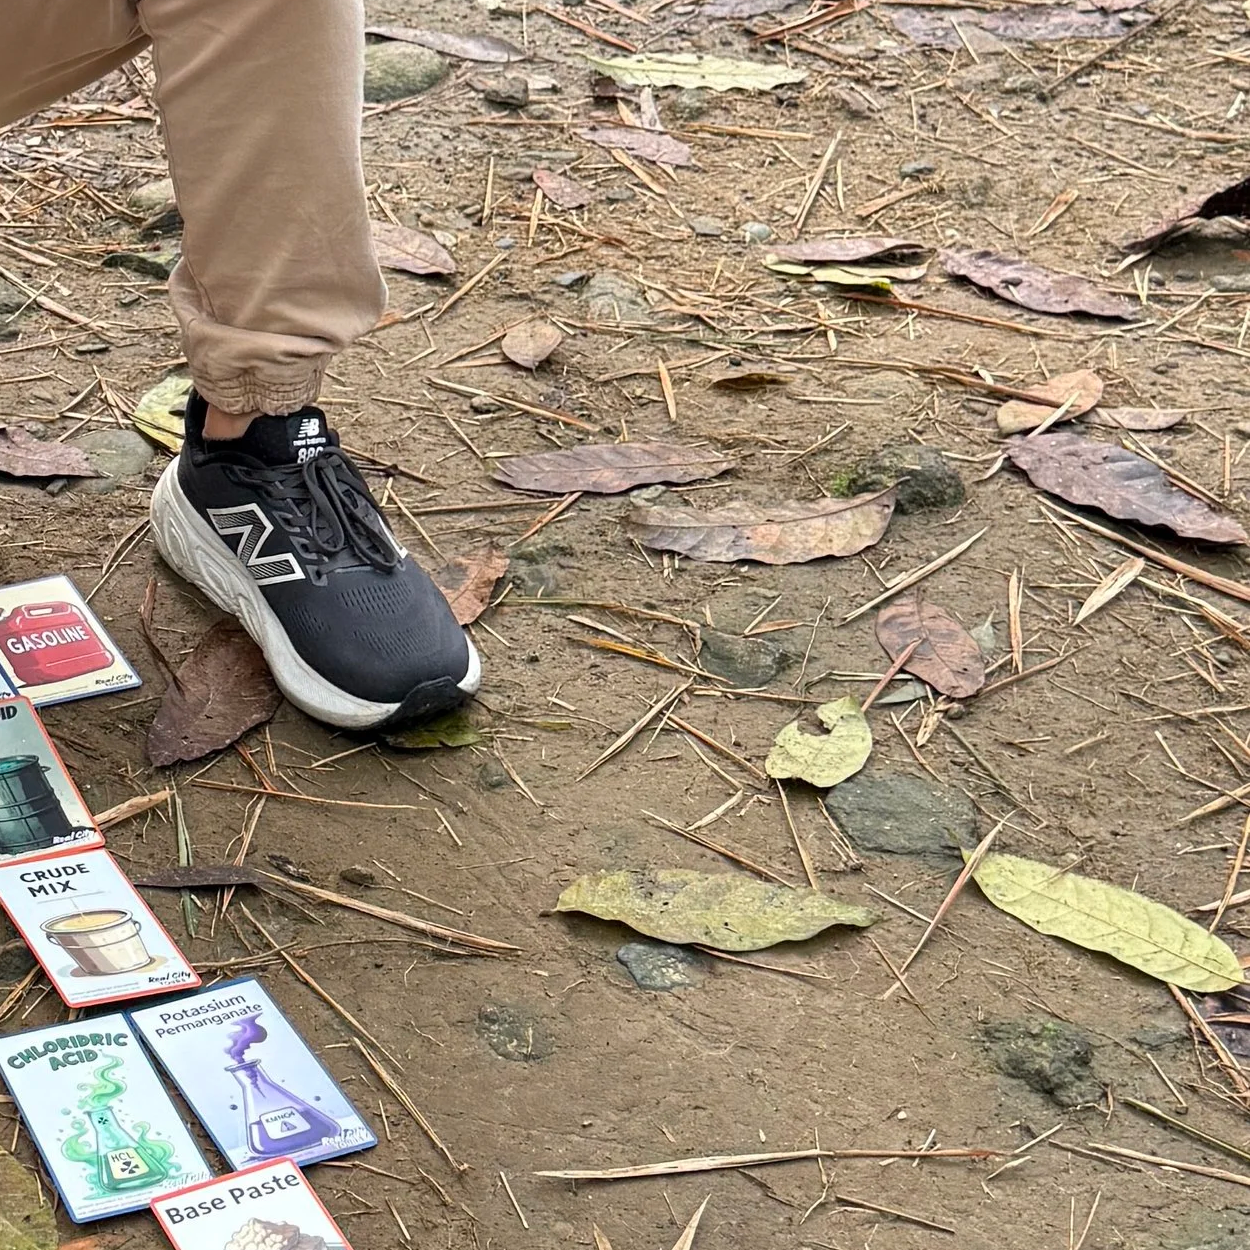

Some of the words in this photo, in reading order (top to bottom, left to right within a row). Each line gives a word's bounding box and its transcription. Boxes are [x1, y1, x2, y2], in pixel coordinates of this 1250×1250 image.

[7, 625, 89, 654] GASOLINE
[19, 863, 90, 883] CRUDE
[27, 880, 78, 898] MIX
[148, 972, 170, 983] Real
[171, 971, 191, 979] City
[155, 1002, 263, 1039] Permanganate
[159, 993, 246, 1024] Potassium
[7, 1032, 128, 1069] CHLORIDRIC
[49, 1049, 98, 1071] ACID
[110, 1151, 134, 1163] HCL
[165, 1197, 227, 1225] Base
[229, 1174, 300, 1204] Paste
